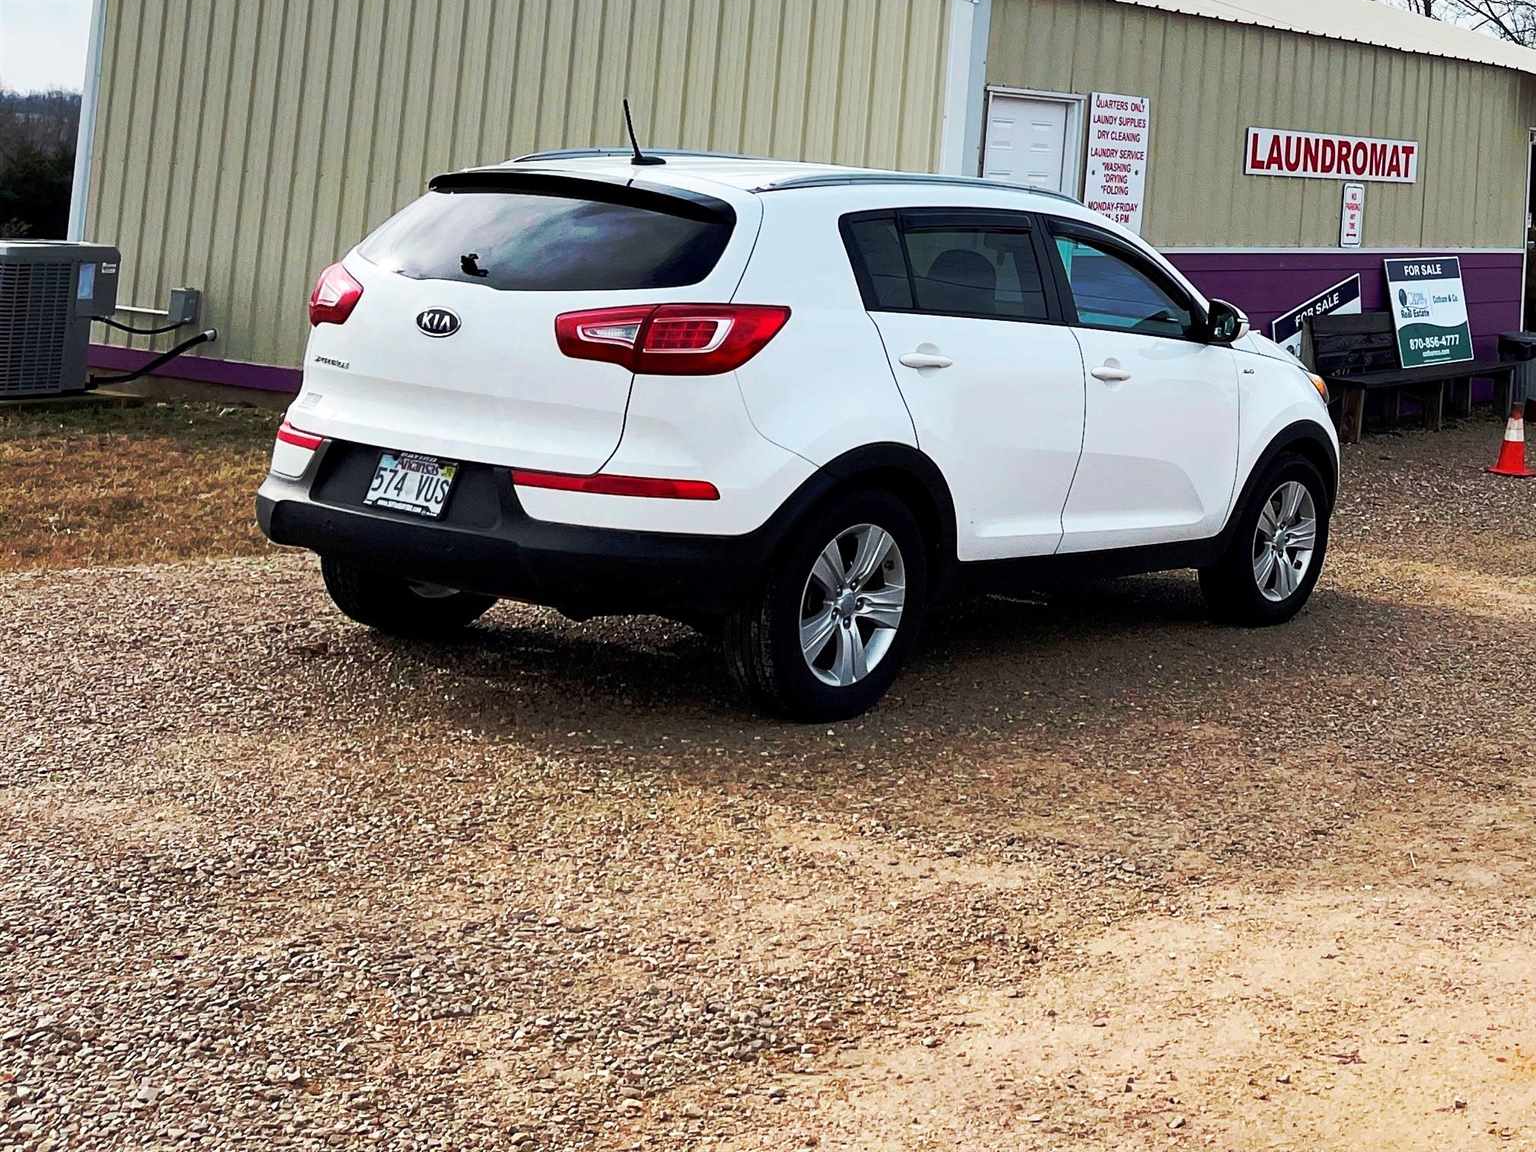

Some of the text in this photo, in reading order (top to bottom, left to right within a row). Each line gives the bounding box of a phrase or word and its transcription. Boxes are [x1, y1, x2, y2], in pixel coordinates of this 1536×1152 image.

[1096, 99, 1145, 112] QUARTERS ONLY
[1119, 117, 1146, 128] SUPPLIES
[1097, 130, 1141, 143] DRY CLEANING
[1091, 148, 1145, 160] LAUNDRY SERVICE
[1250, 133, 1415, 178] LAUNDROMAT
[1404, 264, 1442, 276] FOR SALE
[1295, 292, 1339, 327] FOR SALE
[421, 312, 451, 332] KIA
[1409, 334, 1459, 350] 870-856-4777
[371, 467, 449, 504] 574 VUS
